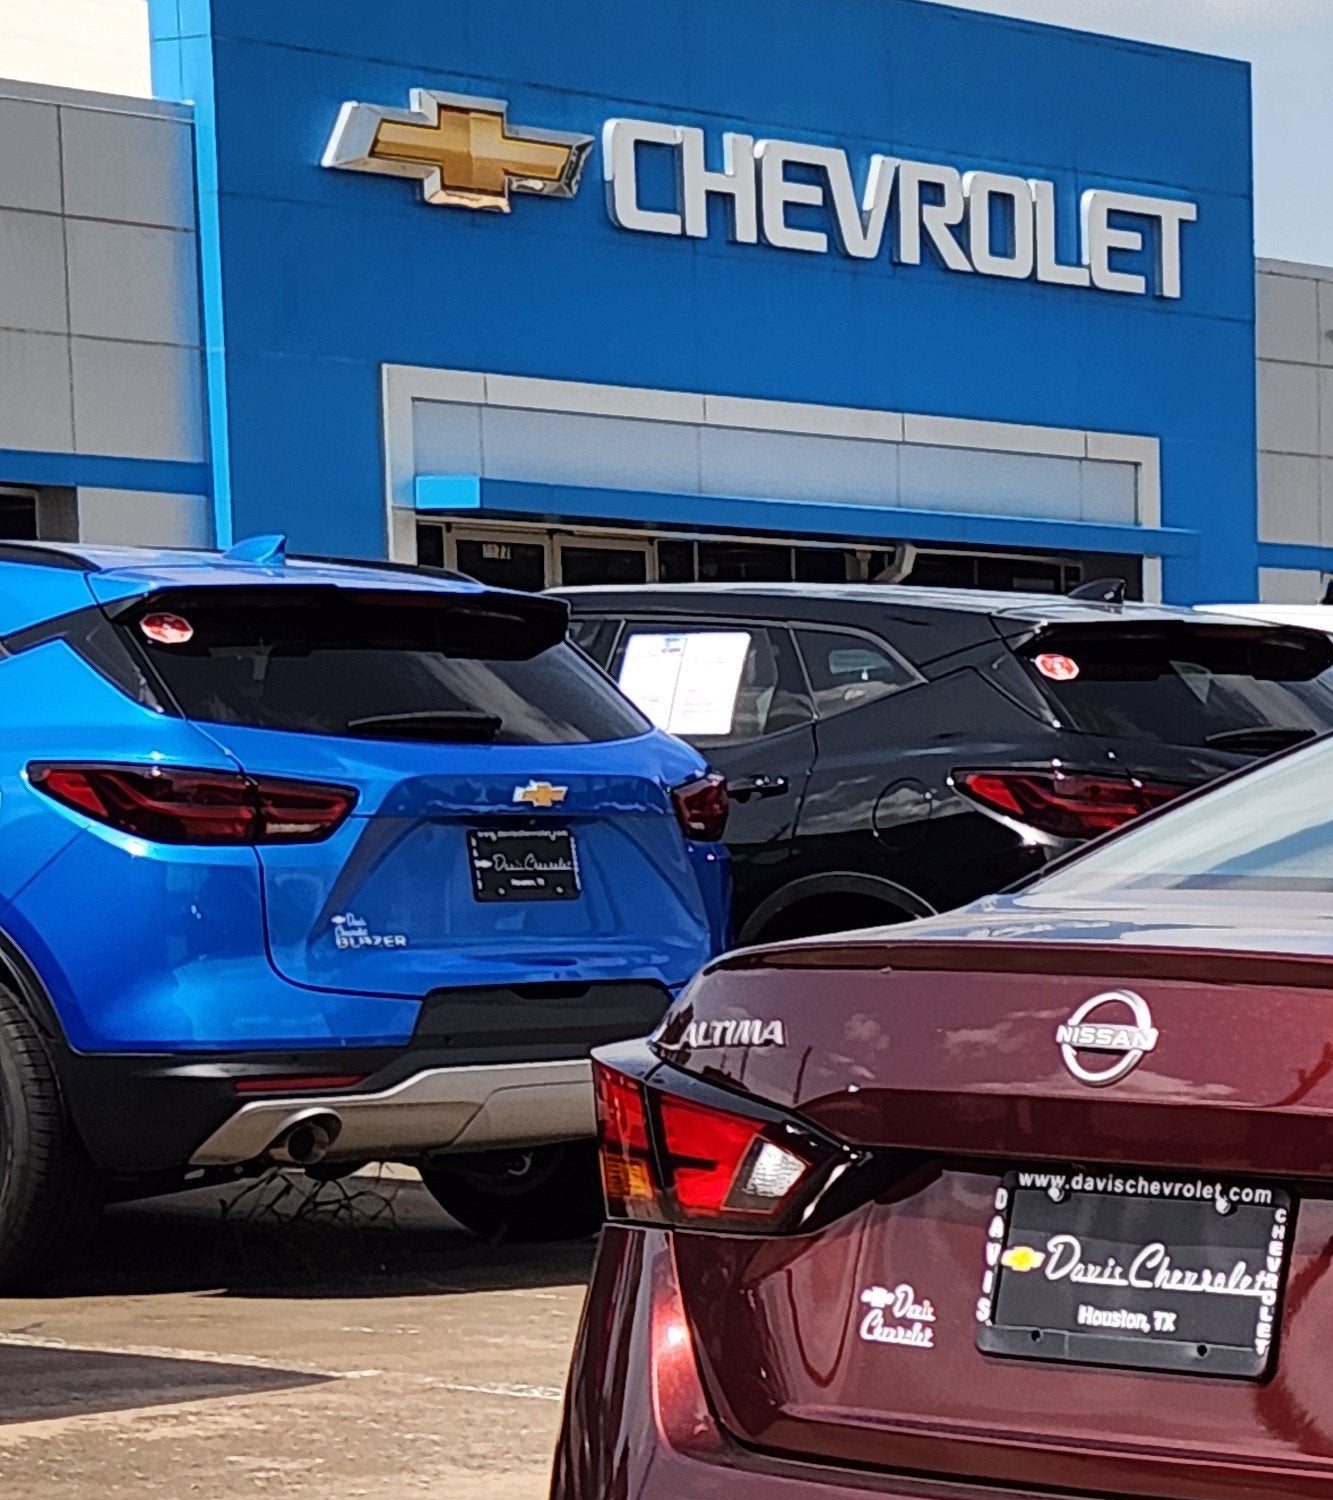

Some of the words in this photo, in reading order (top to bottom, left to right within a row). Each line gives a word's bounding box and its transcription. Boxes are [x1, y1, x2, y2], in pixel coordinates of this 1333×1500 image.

[602, 116, 1197, 300] CHEVROLET
[337, 935, 407, 949] BLAZER
[681, 1018, 785, 1048] ALTIMA
[1056, 1024, 1158, 1051] NISSAN
[1018, 1171, 1273, 1205] www.davischevrolet.com
[976, 1187, 1008, 1326] DAVIS
[1045, 1234, 1130, 1286] Davis
[1128, 1242, 1267, 1296] Chevrolet
[1255, 1207, 1288, 1356] CHEVROLET
[1077, 1303, 1150, 1333] Houston,
[1153, 1309, 1178, 1332] TX
